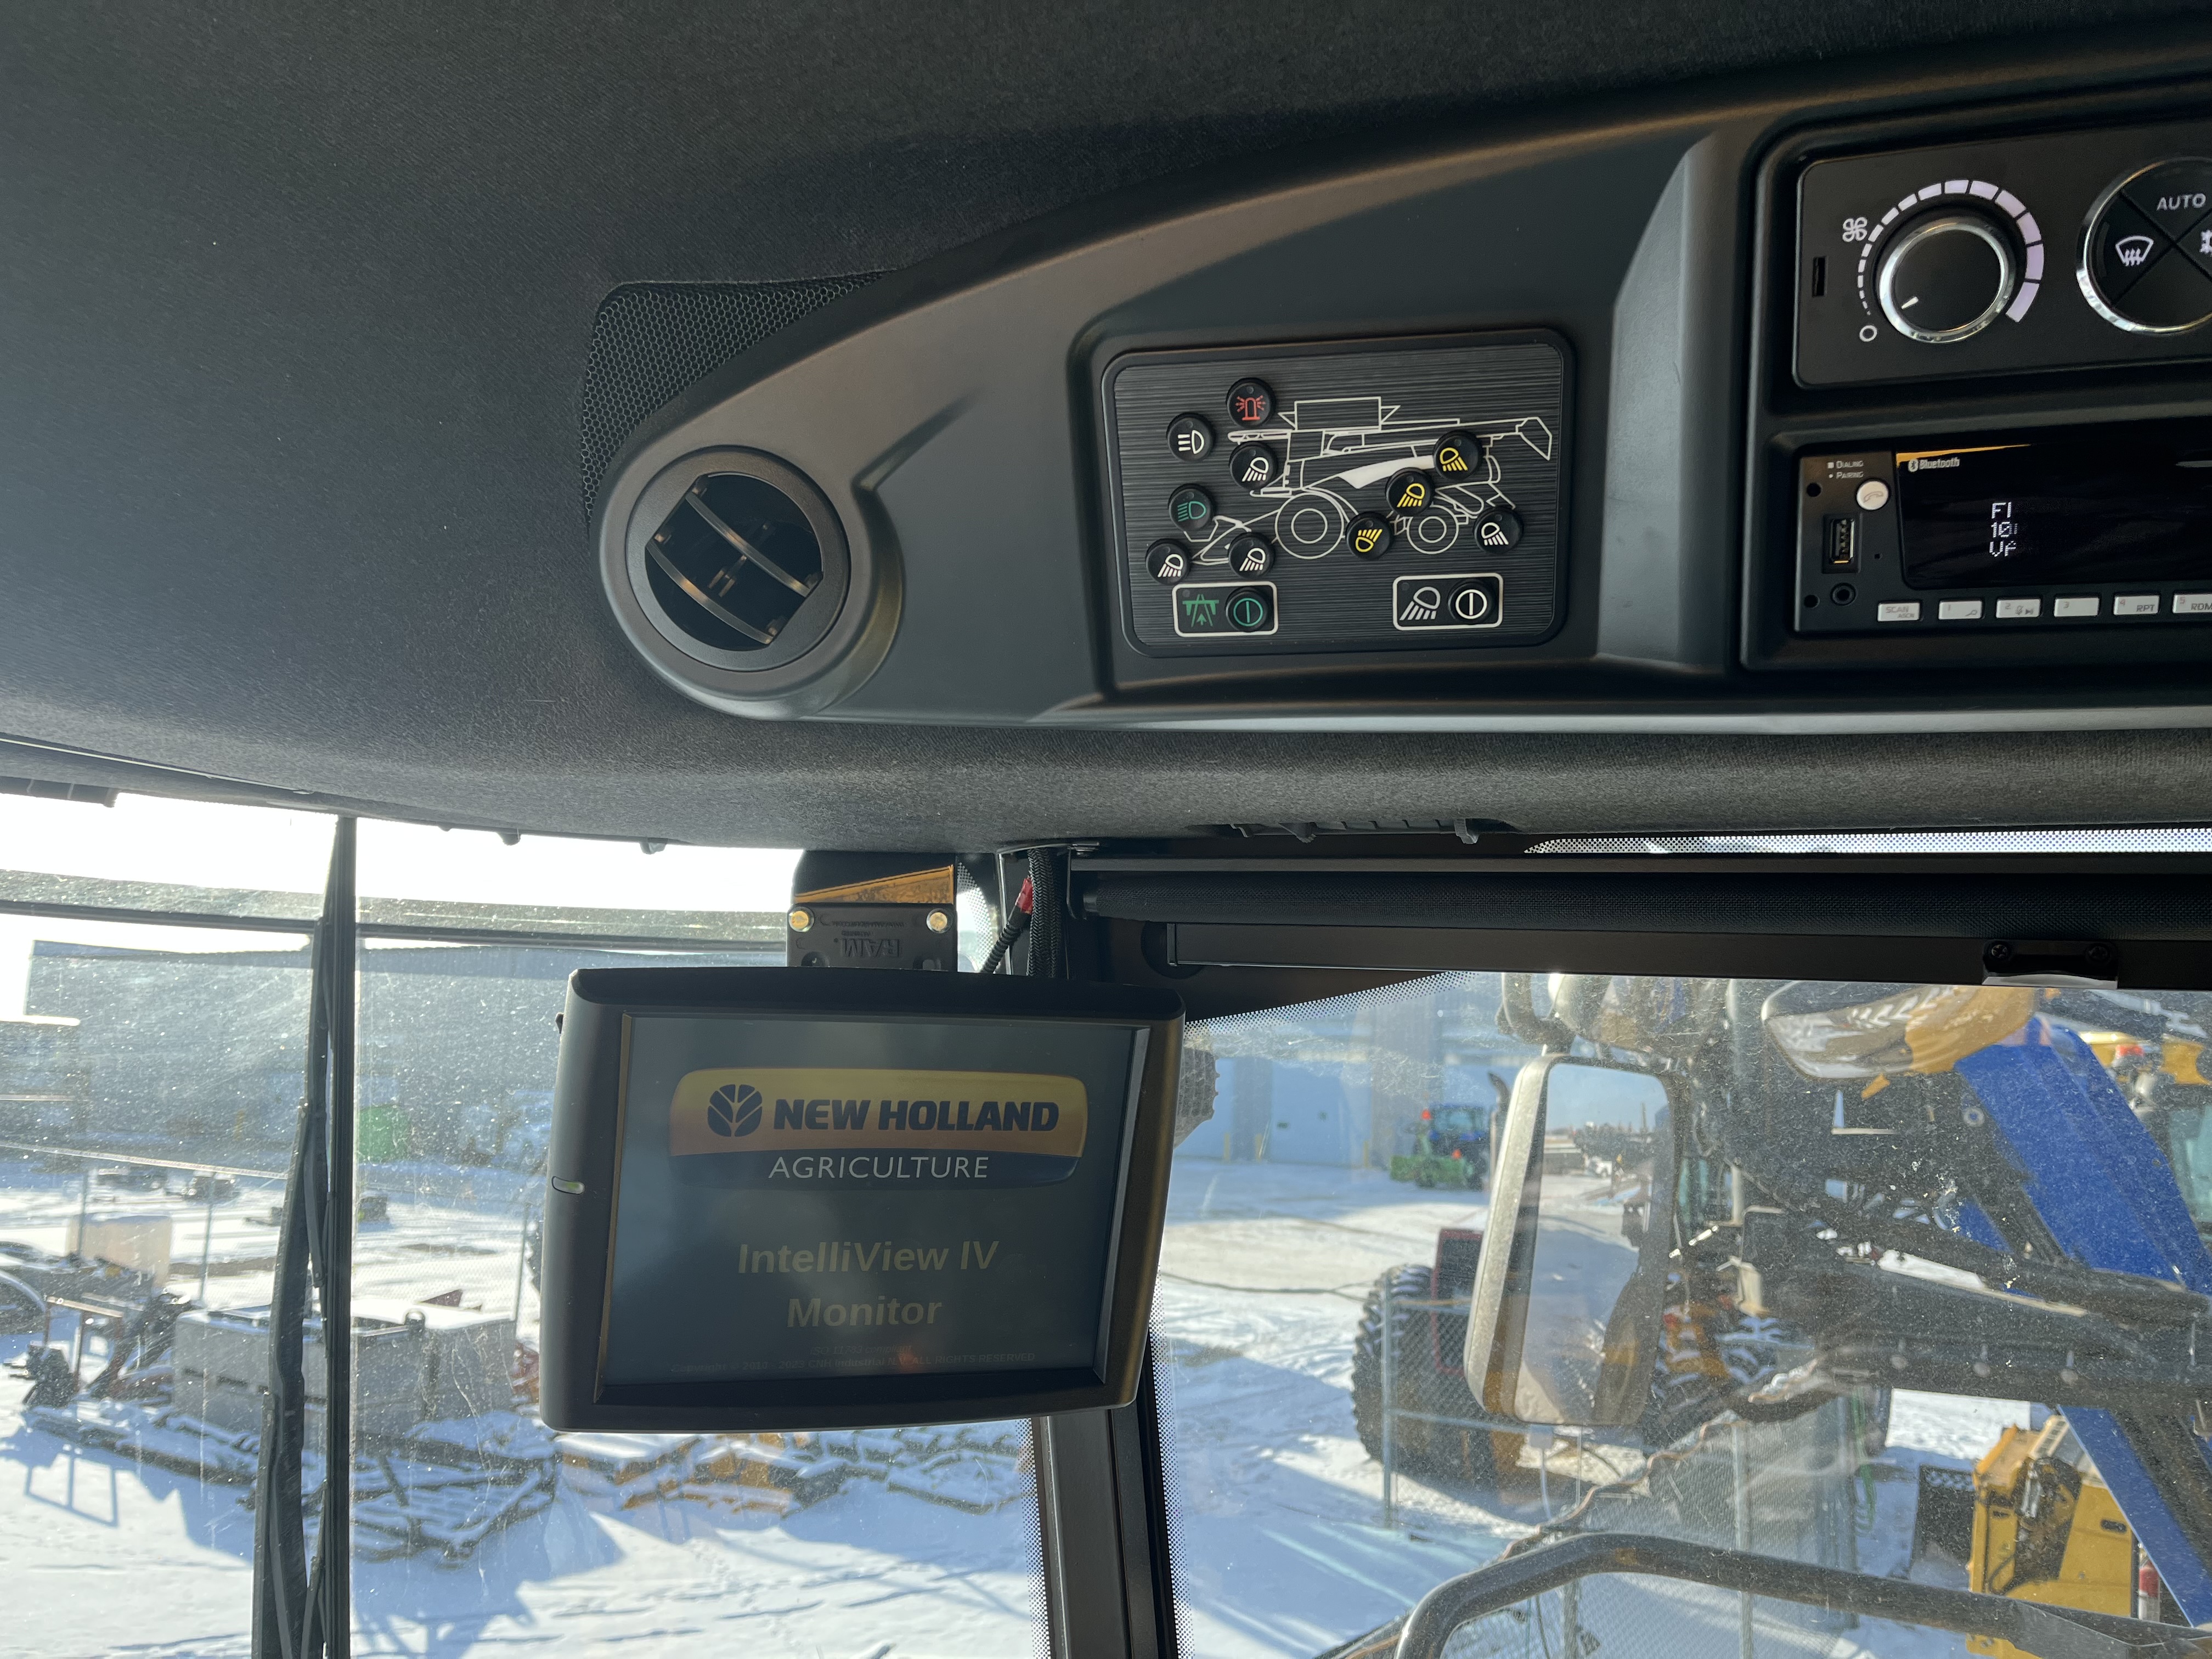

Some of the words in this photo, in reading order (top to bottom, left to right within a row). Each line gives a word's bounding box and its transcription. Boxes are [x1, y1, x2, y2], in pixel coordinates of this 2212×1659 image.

[2157, 193, 2207, 211] AUTO
[1919, 457, 1960, 470] Bluetooth
[2136, 604, 2155, 613] RPT
[774, 1098, 870, 1131] NEW
[878, 1099, 1059, 1132] HOLLAND
[768, 1155, 989, 1179] AGRICULTURE
[738, 1241, 950, 1274] IntelliView
[960, 1240, 1000, 1270] IV
[787, 1295, 943, 1328] Monitor
[935, 1354, 977, 1365] RIGHTS
[978, 1352, 1036, 1363] RESERVED
